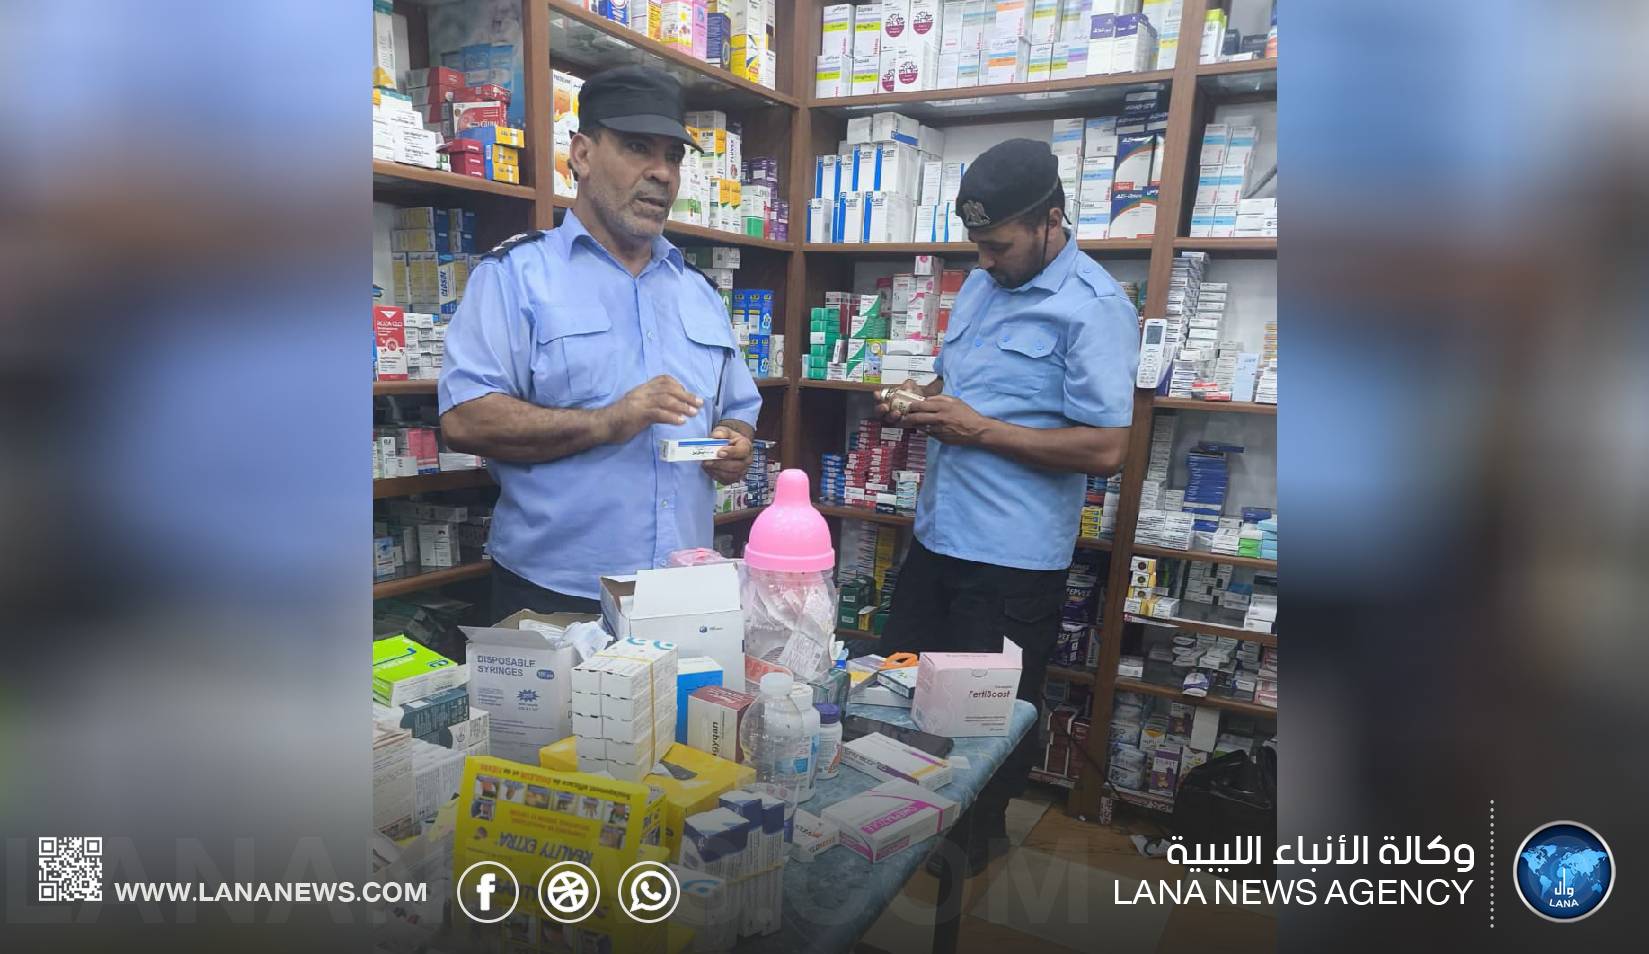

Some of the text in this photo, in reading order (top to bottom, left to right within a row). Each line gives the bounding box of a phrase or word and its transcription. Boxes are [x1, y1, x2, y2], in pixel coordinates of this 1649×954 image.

[477, 655, 537, 667] DISPOSABLE
[477, 665, 524, 677] SYRINGES
[498, 832, 593, 866] REALITY EXTRA
